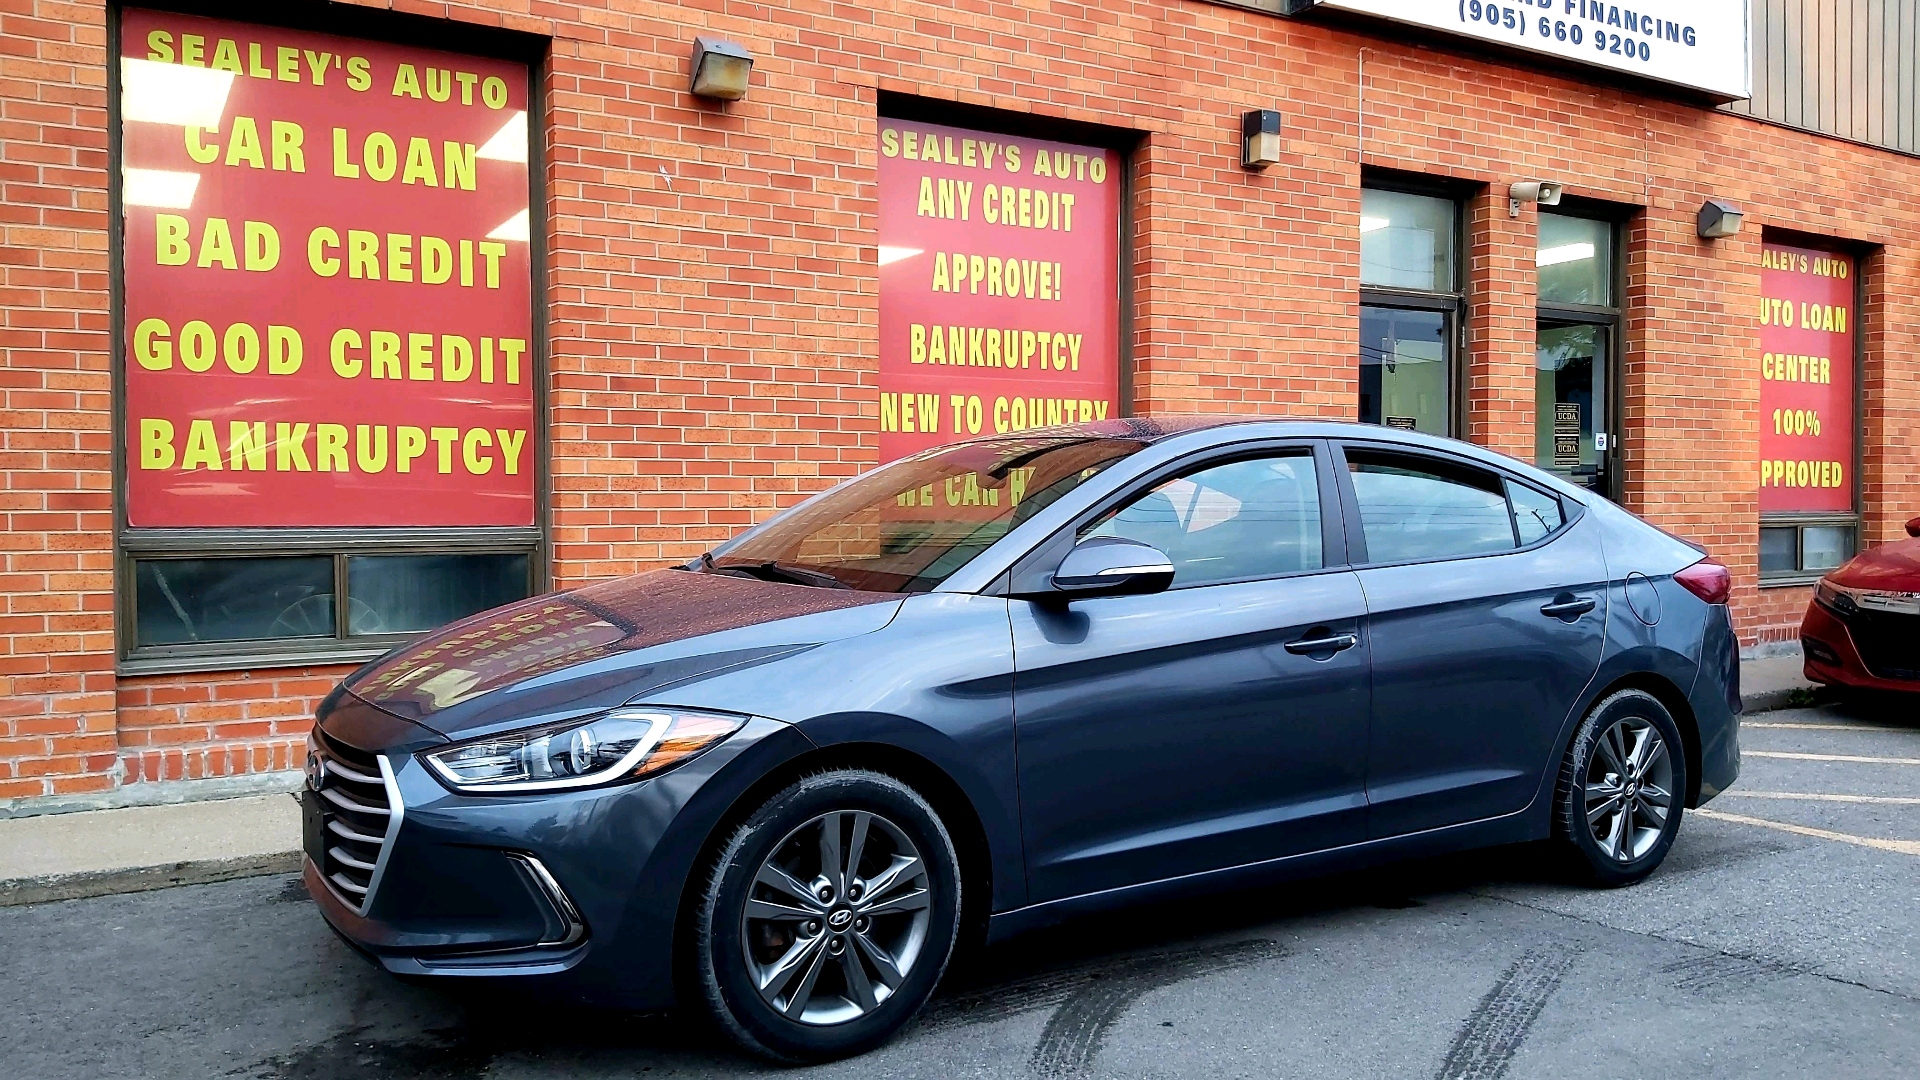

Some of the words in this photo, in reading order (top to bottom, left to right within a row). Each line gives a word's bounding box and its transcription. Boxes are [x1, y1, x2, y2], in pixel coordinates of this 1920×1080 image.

[1458, 0, 1526, 35] (905)
[1538, 16, 1583, 45] 660
[1594, 30, 1651, 62] 9200
[1565, 0, 1696, 46] FINANCING
[147, 30, 372, 92] SEALEY'S
[392, 63, 508, 110] AUTO
[184, 116, 306, 173] CAR
[333, 127, 477, 191] LOAN
[881, 128, 1021, 173] SEALEY'S
[1033, 149, 1107, 184] AUTO
[917, 176, 973, 221] ANY
[983, 183, 1075, 232] CREDIT
[156, 213, 281, 272] BAD
[307, 225, 507, 289] CREDIT
[1761, 249, 1808, 274] ALEY'S
[1812, 256, 1848, 279] AUTO
[932, 251, 1062, 301] APPROVE!
[1760, 297, 1794, 328] UTO
[1801, 302, 1846, 333] LOAN
[133, 318, 304, 375] GOOD
[330, 328, 526, 385] CREDIT
[910, 323, 1083, 371] BANKRUPTCY
[1762, 352, 1831, 384] CENTER
[880, 392, 941, 433] NEW
[950, 394, 983, 435] TO
[1558, 412, 1577, 420] UCDA
[1773, 408, 1821, 437] 100%
[140, 418, 527, 475] BANKRUPTCY
[1558, 445, 1577, 453] UCDA
[1761, 459, 1843, 488] PPROVED
